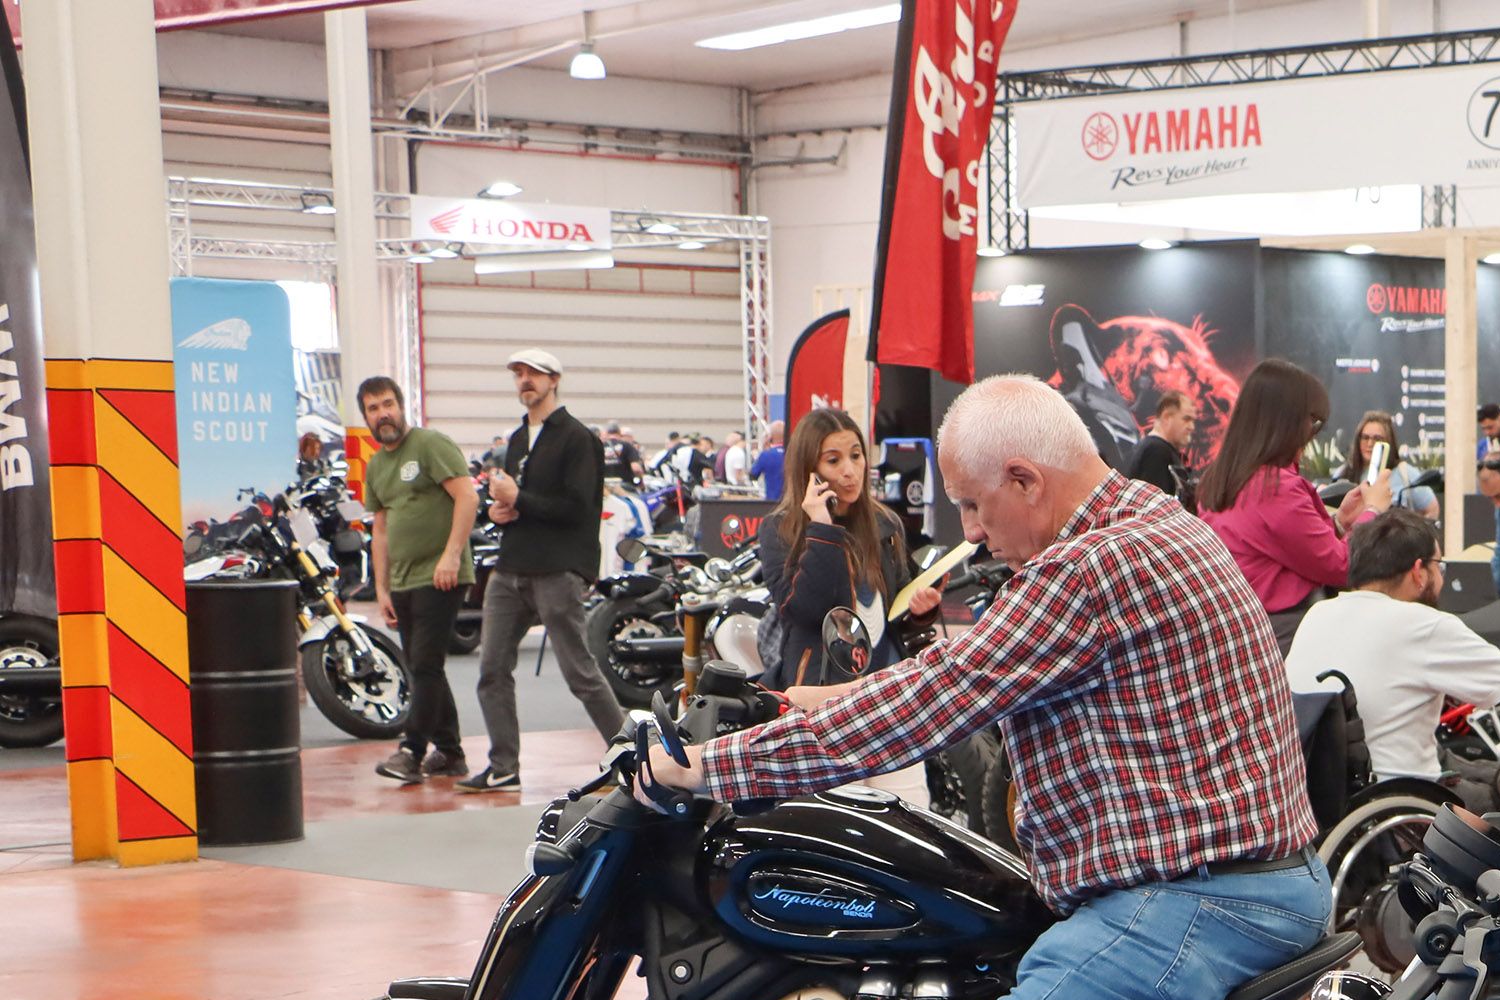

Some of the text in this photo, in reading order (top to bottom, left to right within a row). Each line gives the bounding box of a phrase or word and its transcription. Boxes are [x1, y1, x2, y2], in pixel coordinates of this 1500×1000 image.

[1122, 103, 1262, 155] YAMAHA
[1110, 157, 1249, 190] Revs Your Heart
[472, 217, 593, 242] HONDA
[191, 362, 239, 384] NEW
[191, 392, 273, 414] INDIAN
[192, 421, 268, 442] SCOUT
[755, 884, 876, 913] Napoleonbob
[843, 910, 873, 919] BENDA
